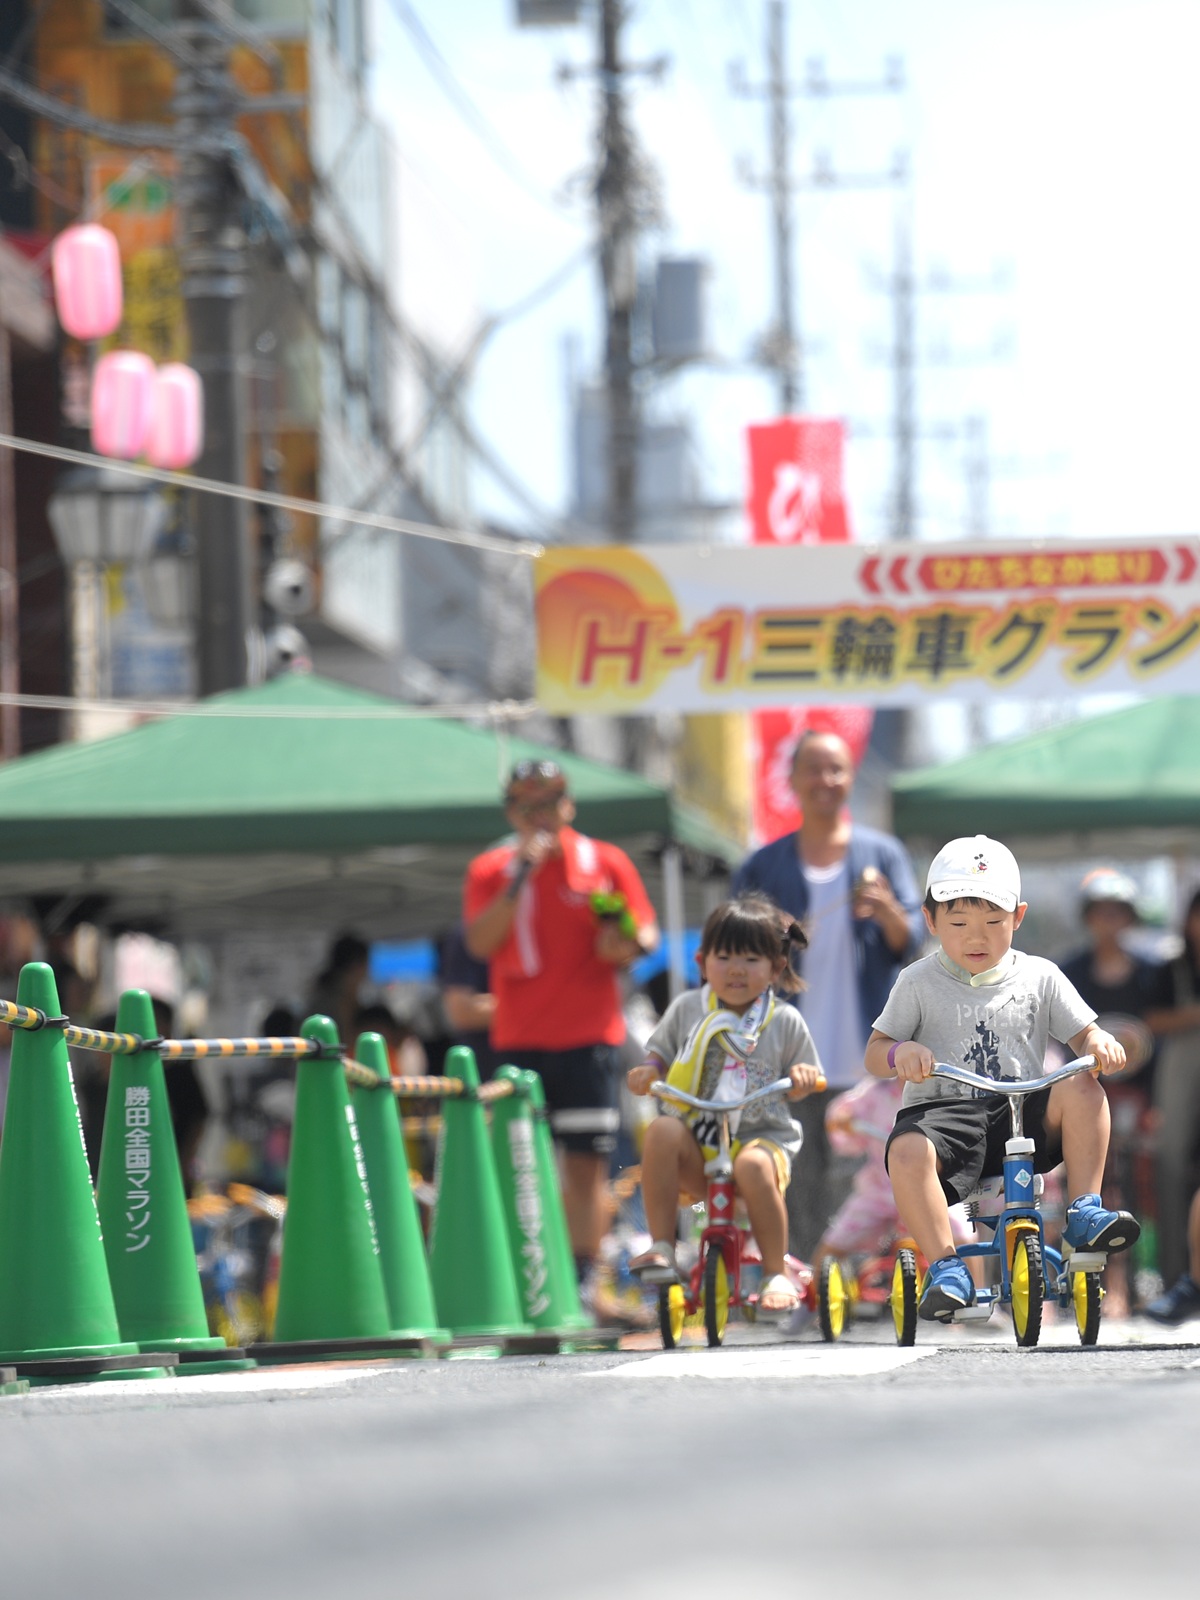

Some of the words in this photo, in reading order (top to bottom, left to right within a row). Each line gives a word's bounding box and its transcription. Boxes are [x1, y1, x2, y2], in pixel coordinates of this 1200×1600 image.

[124, 1085, 152, 1252] 勝田全国マラソン
